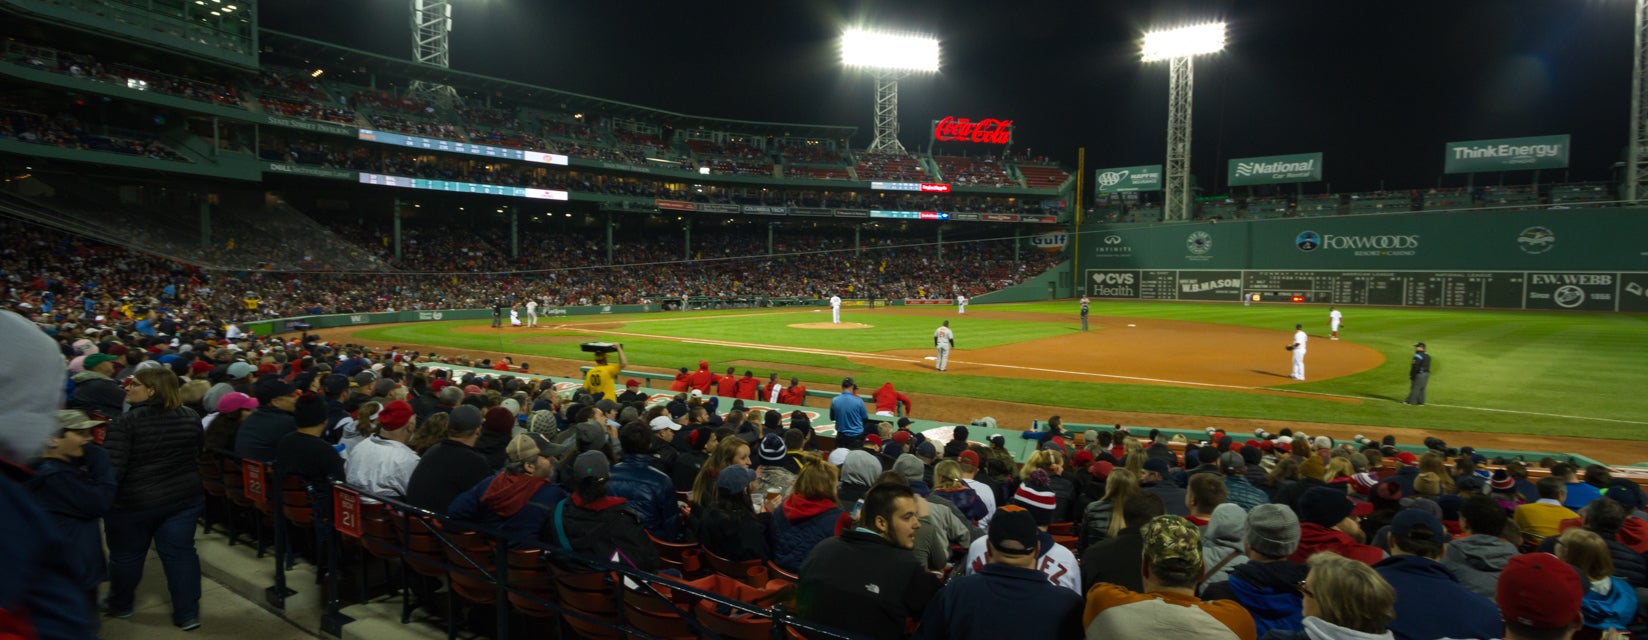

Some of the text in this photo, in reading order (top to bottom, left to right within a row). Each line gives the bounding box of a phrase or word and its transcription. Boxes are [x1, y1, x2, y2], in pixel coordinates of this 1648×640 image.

[1453, 144, 1558, 159] ThinkEnergy
[270, 163, 292, 172] DELL
[1251, 160, 1314, 174] National
[1032, 234, 1066, 245] Gulf
[1323, 235, 1418, 249] FOXWOODS
[1106, 273, 1134, 285] CVS
[1562, 275, 1612, 285] WEBB
[1093, 284, 1134, 296] Health
[249, 480, 261, 495] 22
[342, 511, 355, 528] 21
